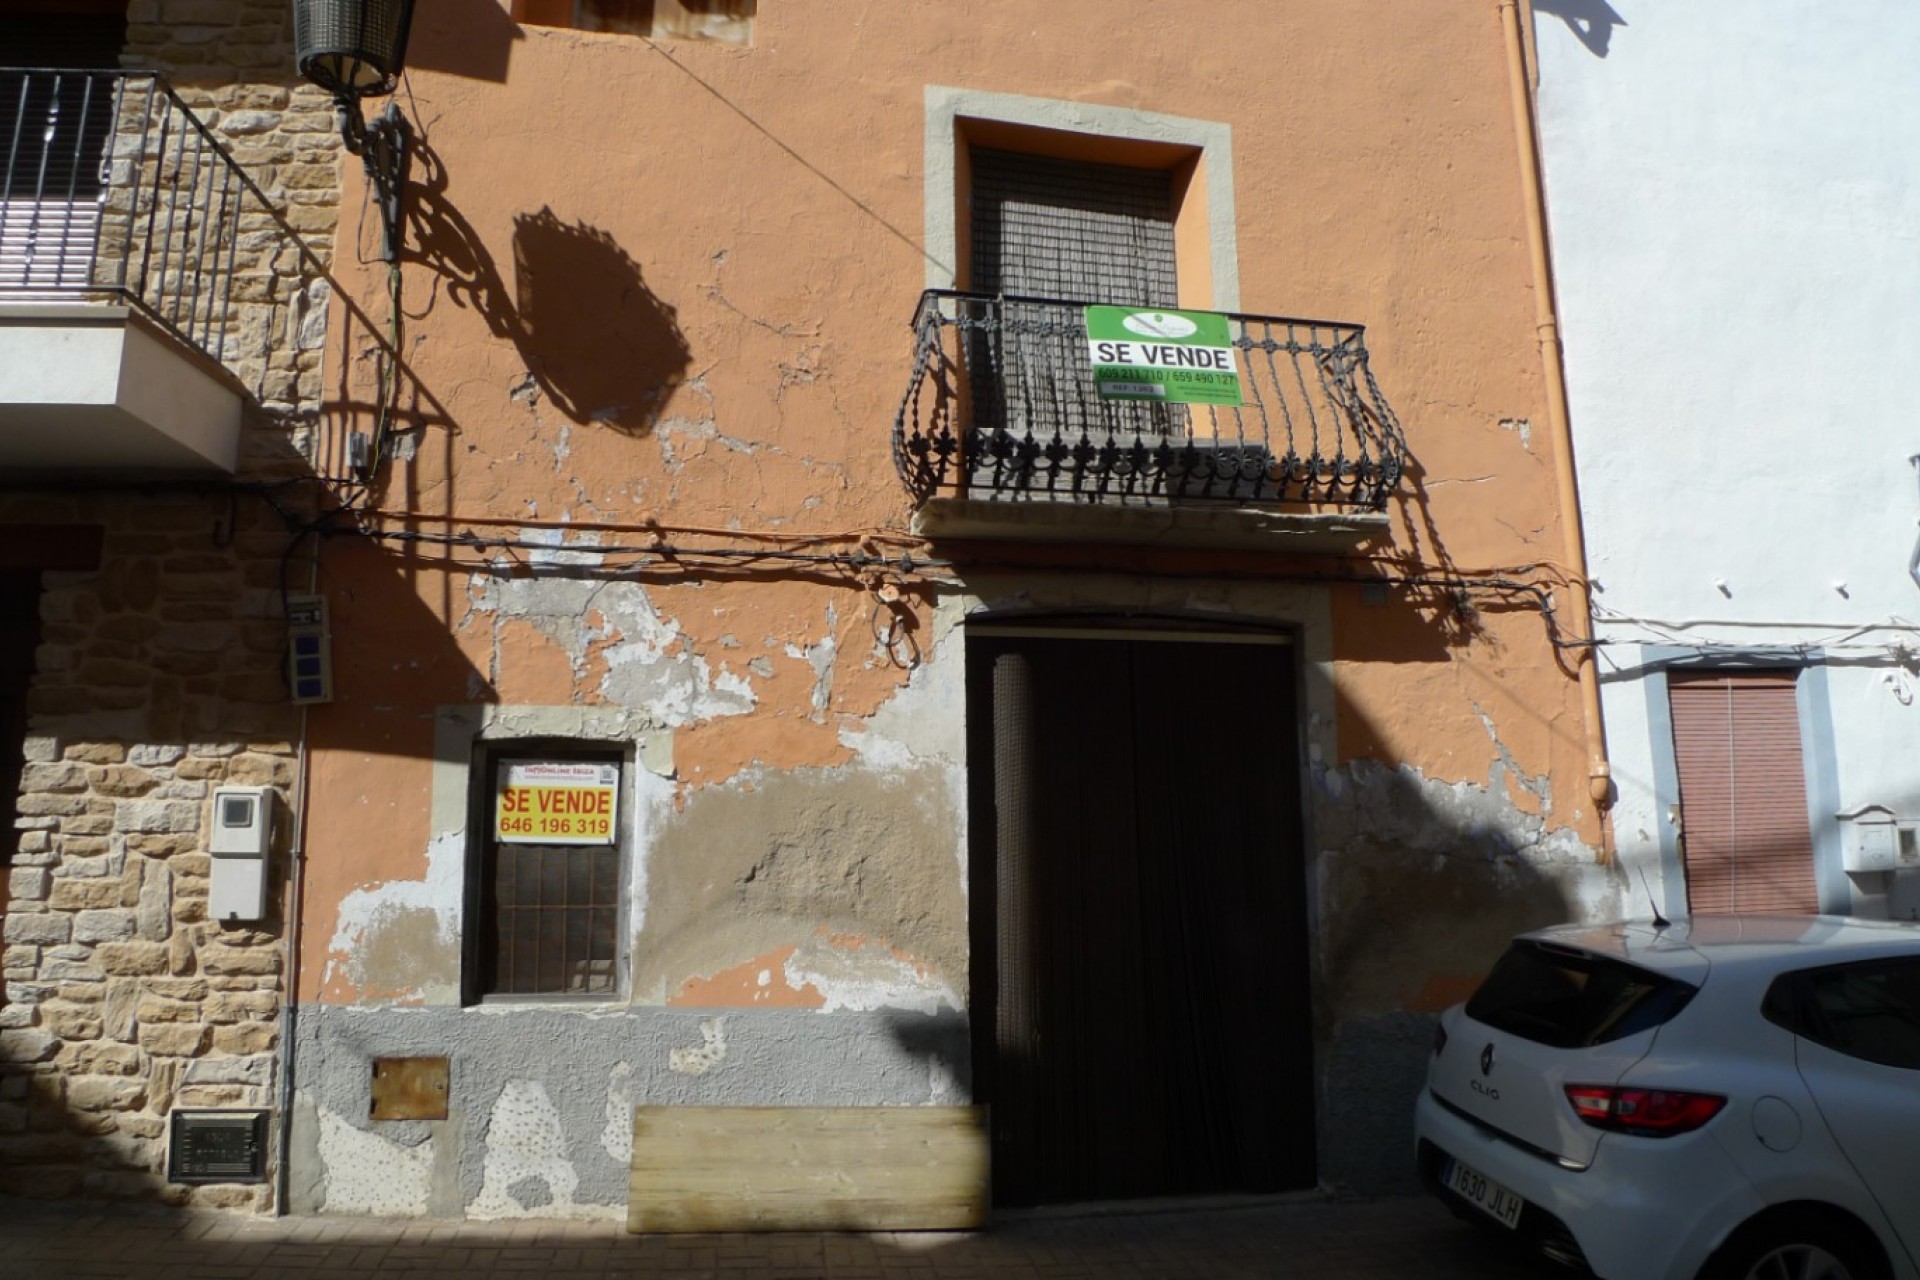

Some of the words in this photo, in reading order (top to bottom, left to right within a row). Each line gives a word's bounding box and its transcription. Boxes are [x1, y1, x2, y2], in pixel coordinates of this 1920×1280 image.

[1098, 343, 1132, 363] SE
[1141, 344, 1230, 369] VENDE
[1098, 369, 1119, 379] 609
[1143, 370, 1164, 381] 710
[1173, 371, 1193, 382] 659
[1195, 372, 1214, 384] 490
[1217, 374, 1234, 386] 127
[502, 788, 531, 813] SE
[537, 789, 611, 814] VENDE
[500, 817, 532, 832] 646
[539, 818, 570, 833] 196
[576, 819, 609, 834] 319
[1470, 1078, 1500, 1100] CLIO
[1454, 1165, 1487, 1202] 1630
[1487, 1188, 1519, 1224] JLH
